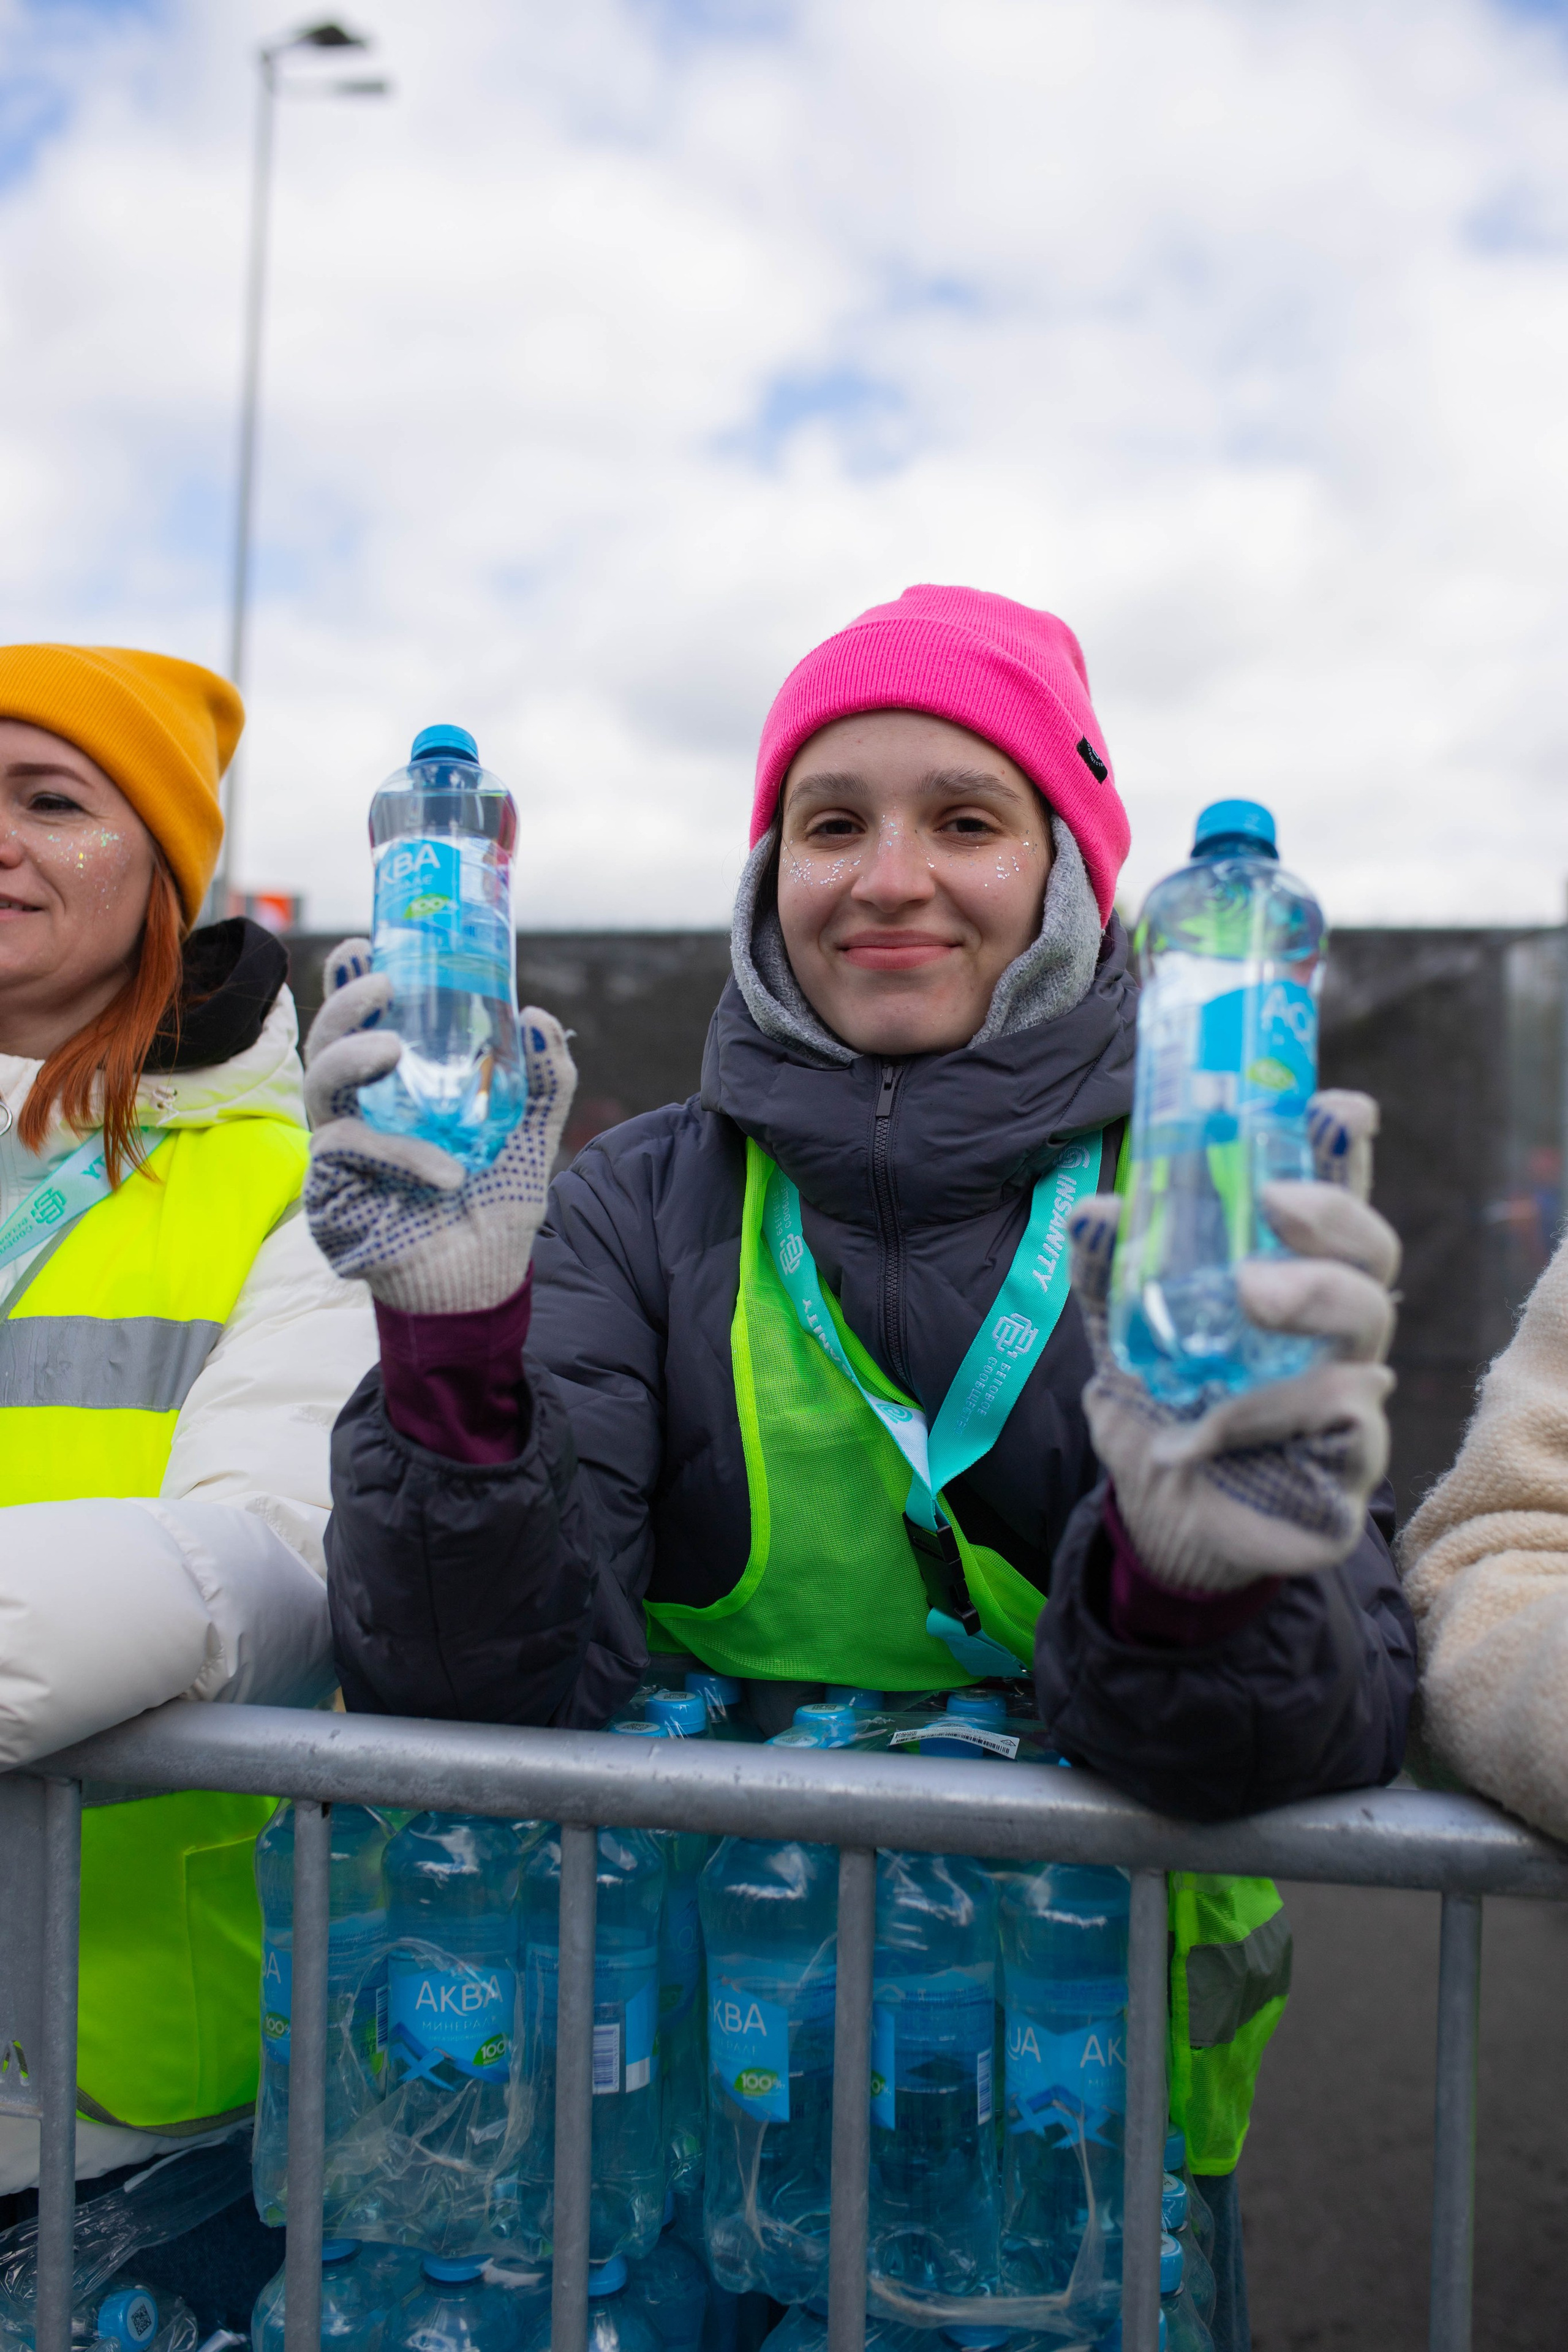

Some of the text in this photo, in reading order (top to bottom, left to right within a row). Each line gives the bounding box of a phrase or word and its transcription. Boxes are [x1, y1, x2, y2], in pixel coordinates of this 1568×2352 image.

[377, 843, 441, 884] КВА
[1032, 1173, 1077, 1293] INSANITY
[977, 1362, 1011, 1416] БЕГОВОЕ
[415, 1975, 503, 2017] АКВА
[714, 1997, 767, 2037] КВА
[1080, 2034, 1126, 2068] АК
